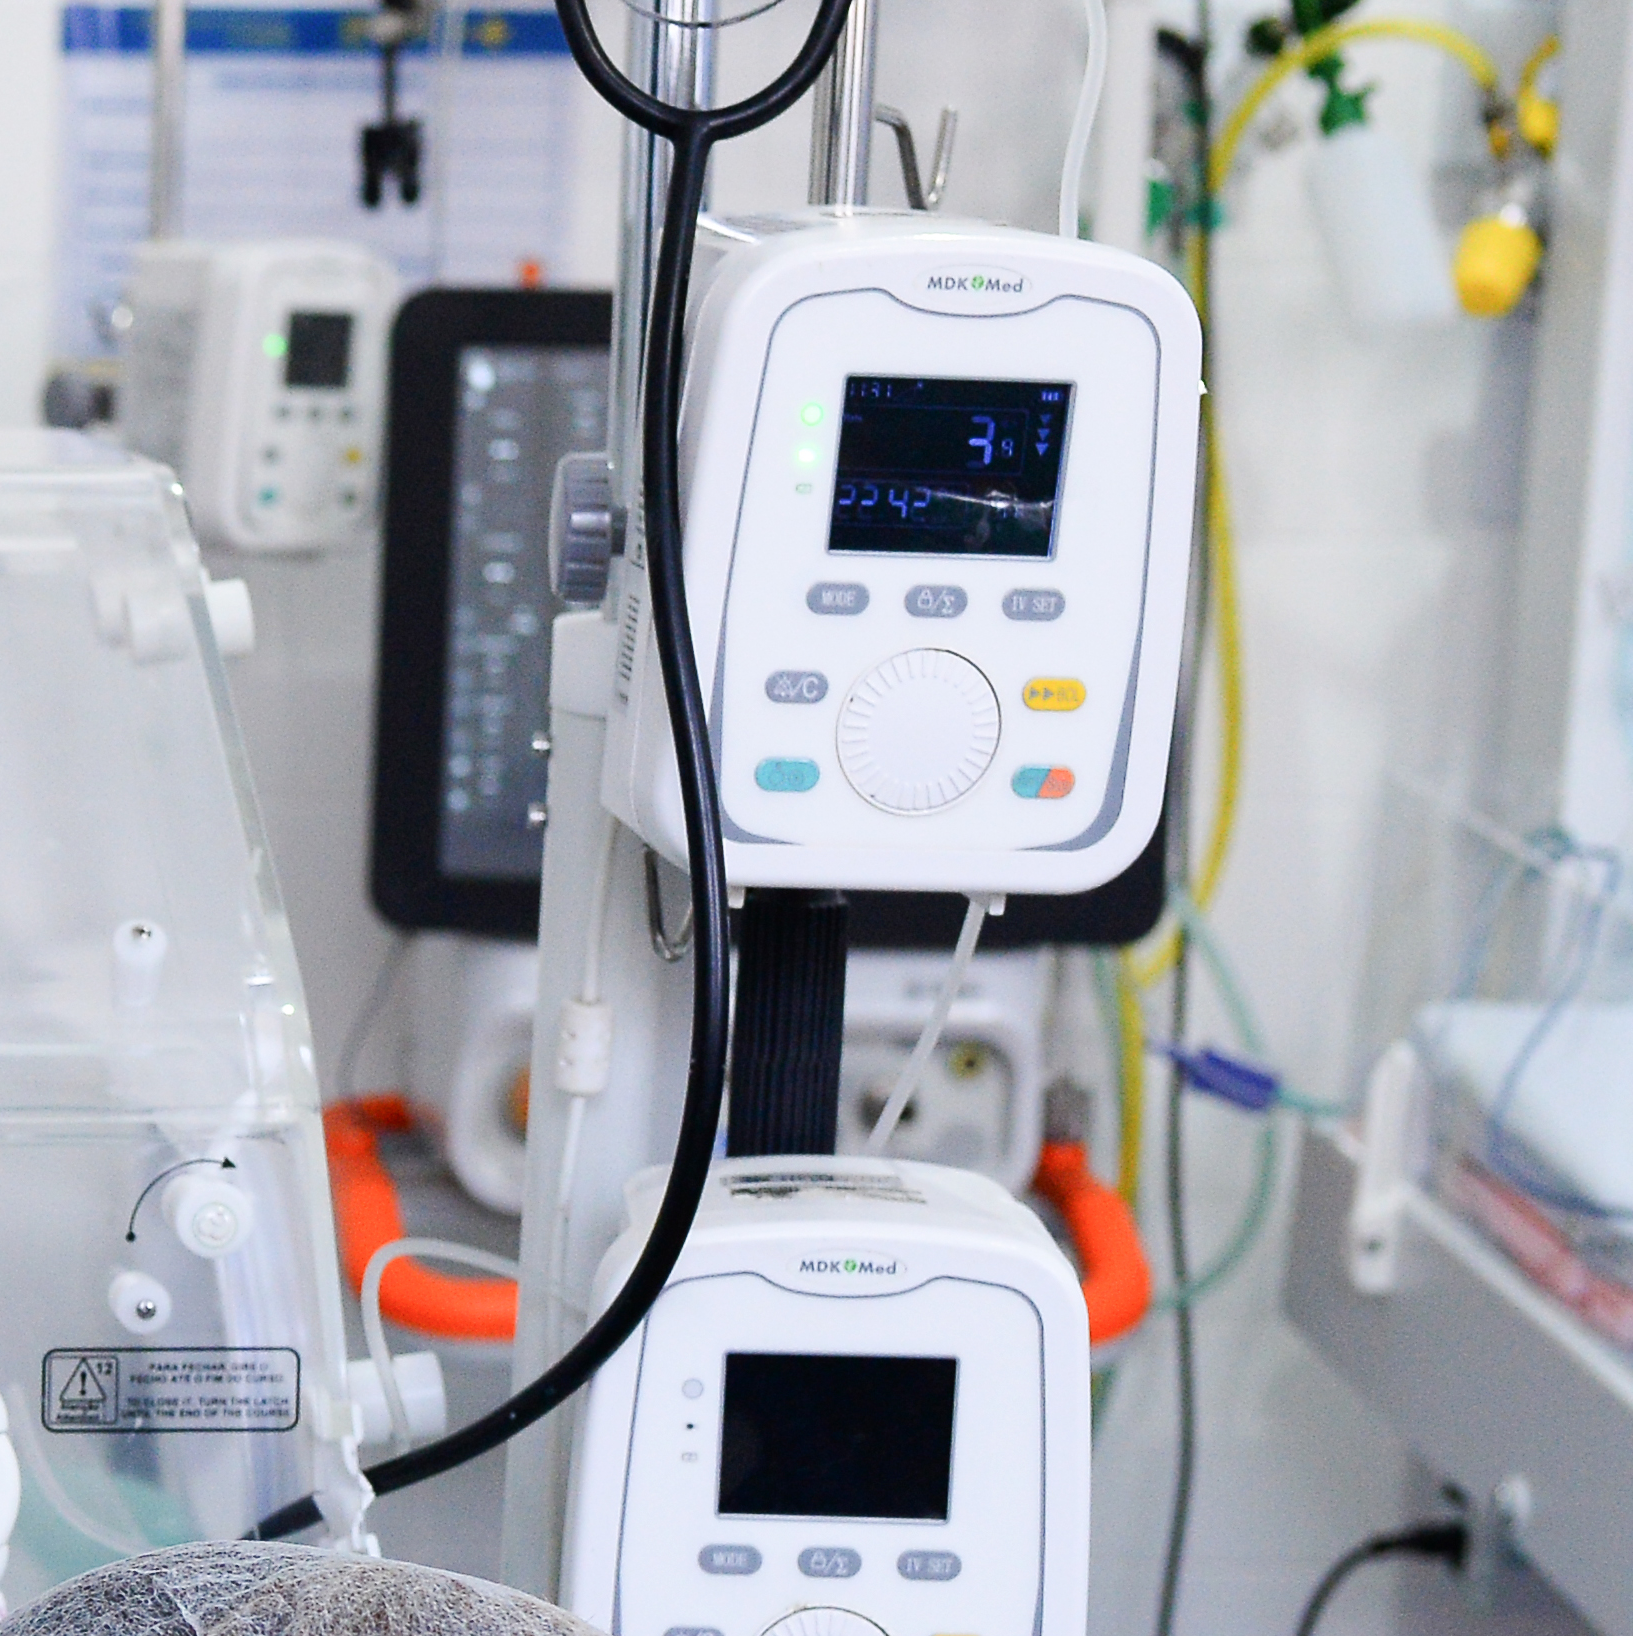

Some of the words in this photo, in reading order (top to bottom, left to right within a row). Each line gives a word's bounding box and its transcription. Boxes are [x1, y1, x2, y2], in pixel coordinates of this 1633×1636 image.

[927, 276, 968, 292] MDK
[985, 276, 1024, 292] Med
[1033, 596, 1058, 612] SET
[799, 1260, 840, 1274] MDK
[858, 1260, 897, 1274] Med
[929, 1559, 953, 1573] SET
